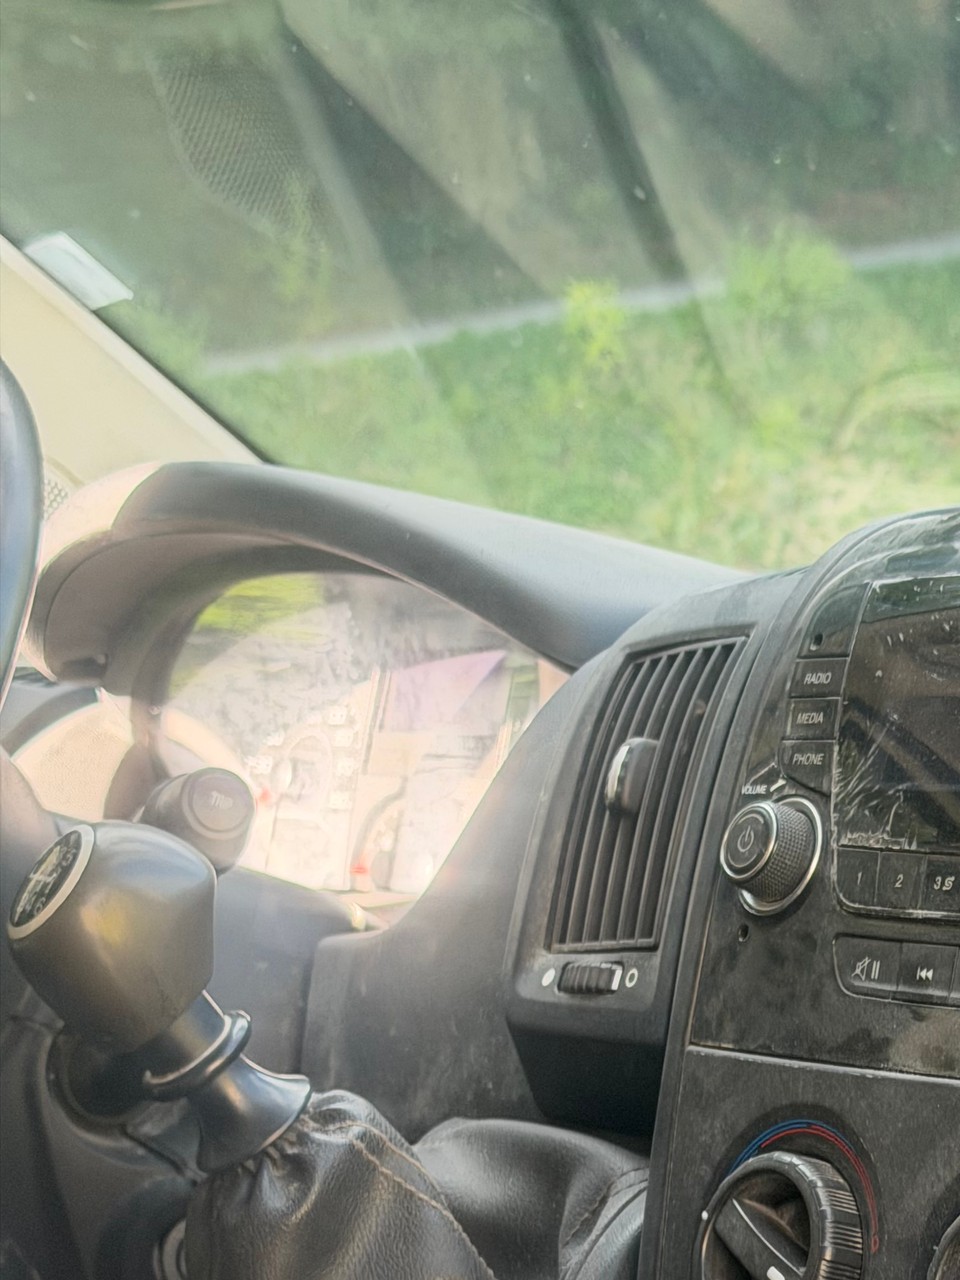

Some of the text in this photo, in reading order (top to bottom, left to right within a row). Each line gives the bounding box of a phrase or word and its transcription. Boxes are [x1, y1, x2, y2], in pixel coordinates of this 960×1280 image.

[803, 672, 832, 685] RADIO
[796, 712, 824, 725] MEDIA
[792, 753, 825, 766] PHONE
[741, 784, 768, 795] VOLUME
[856, 872, 862, 886] 1
[894, 873, 904, 888] 2
[933, 876, 943, 891] 3
